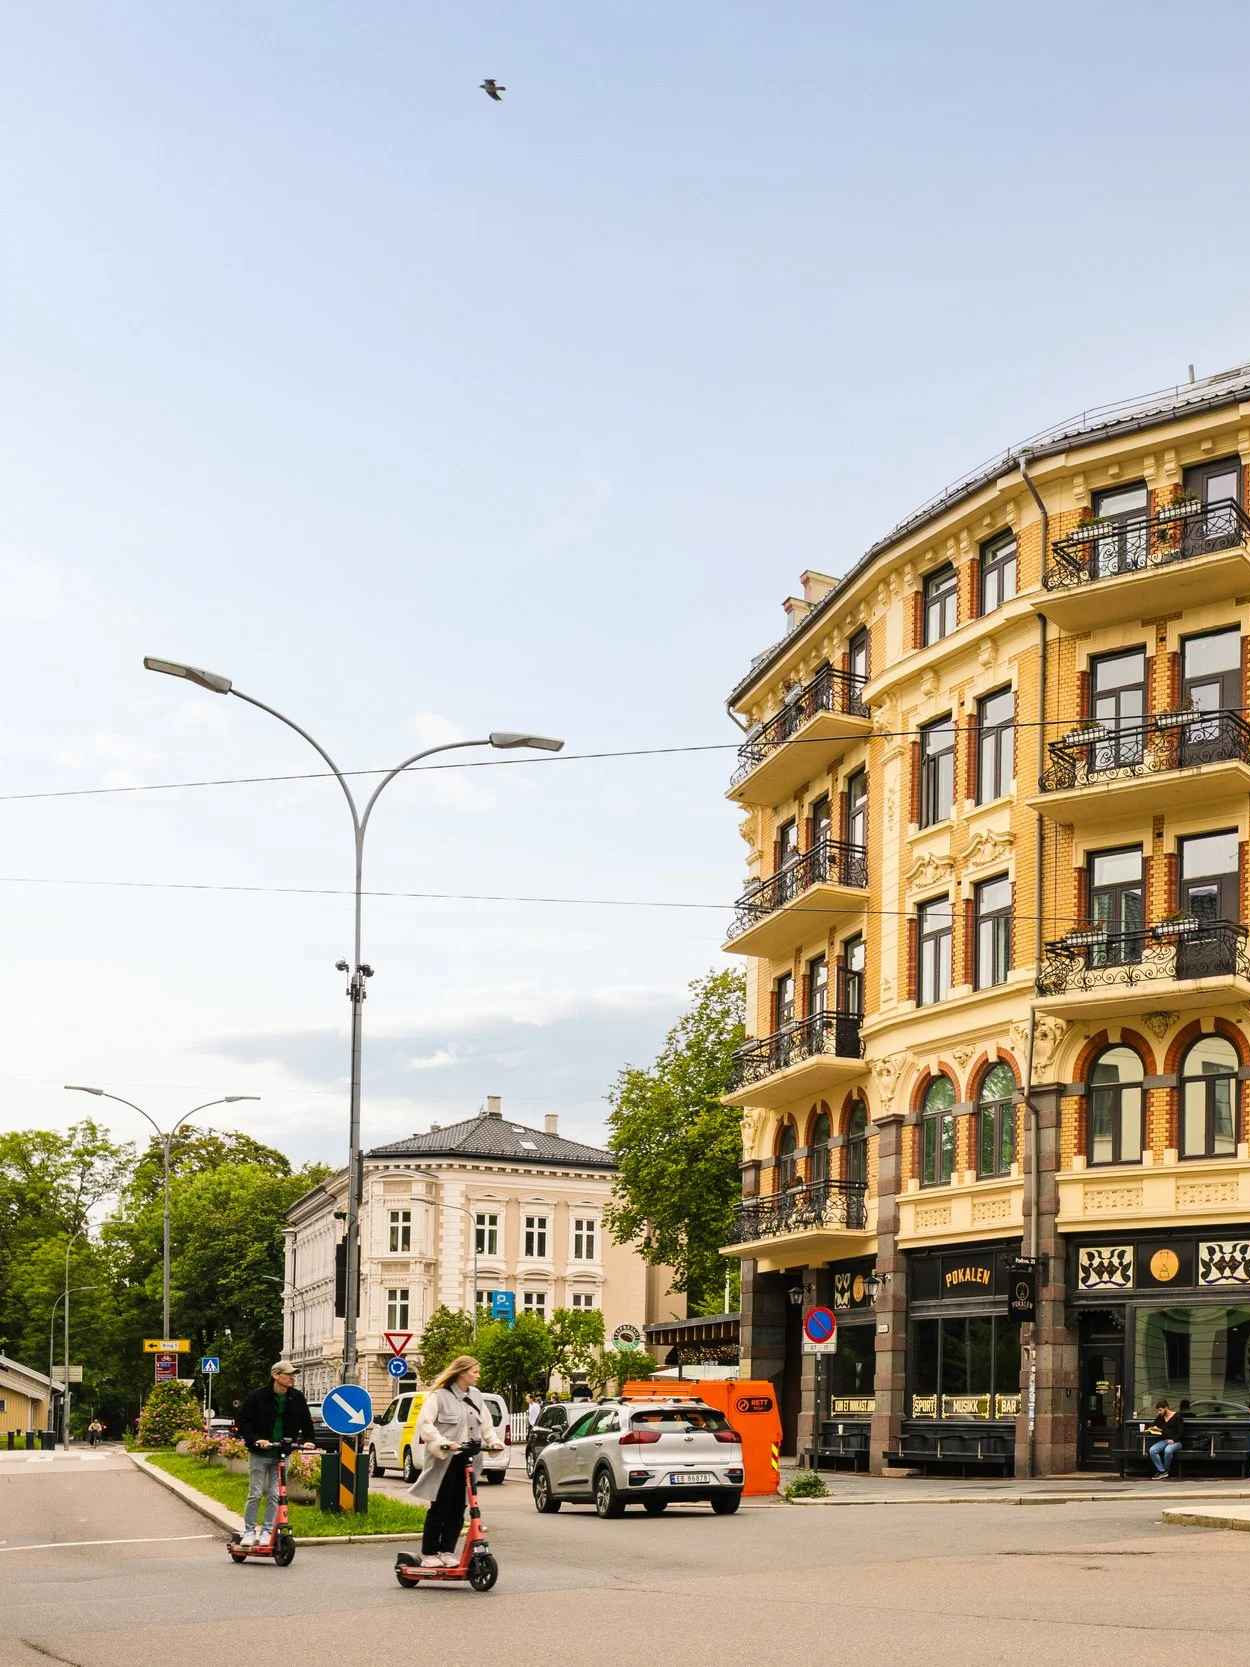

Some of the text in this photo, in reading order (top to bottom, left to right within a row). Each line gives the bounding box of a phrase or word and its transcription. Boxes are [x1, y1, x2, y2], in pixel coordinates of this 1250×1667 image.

[945, 1267, 991, 1288] POKALEN
[1011, 1300, 1034, 1309] POKALEN
[614, 1325, 639, 1336] ESPRESSO
[914, 1399, 935, 1413] SPORT
[953, 1400, 979, 1413] MUSIKK
[1001, 1400, 1017, 1413] BAR
